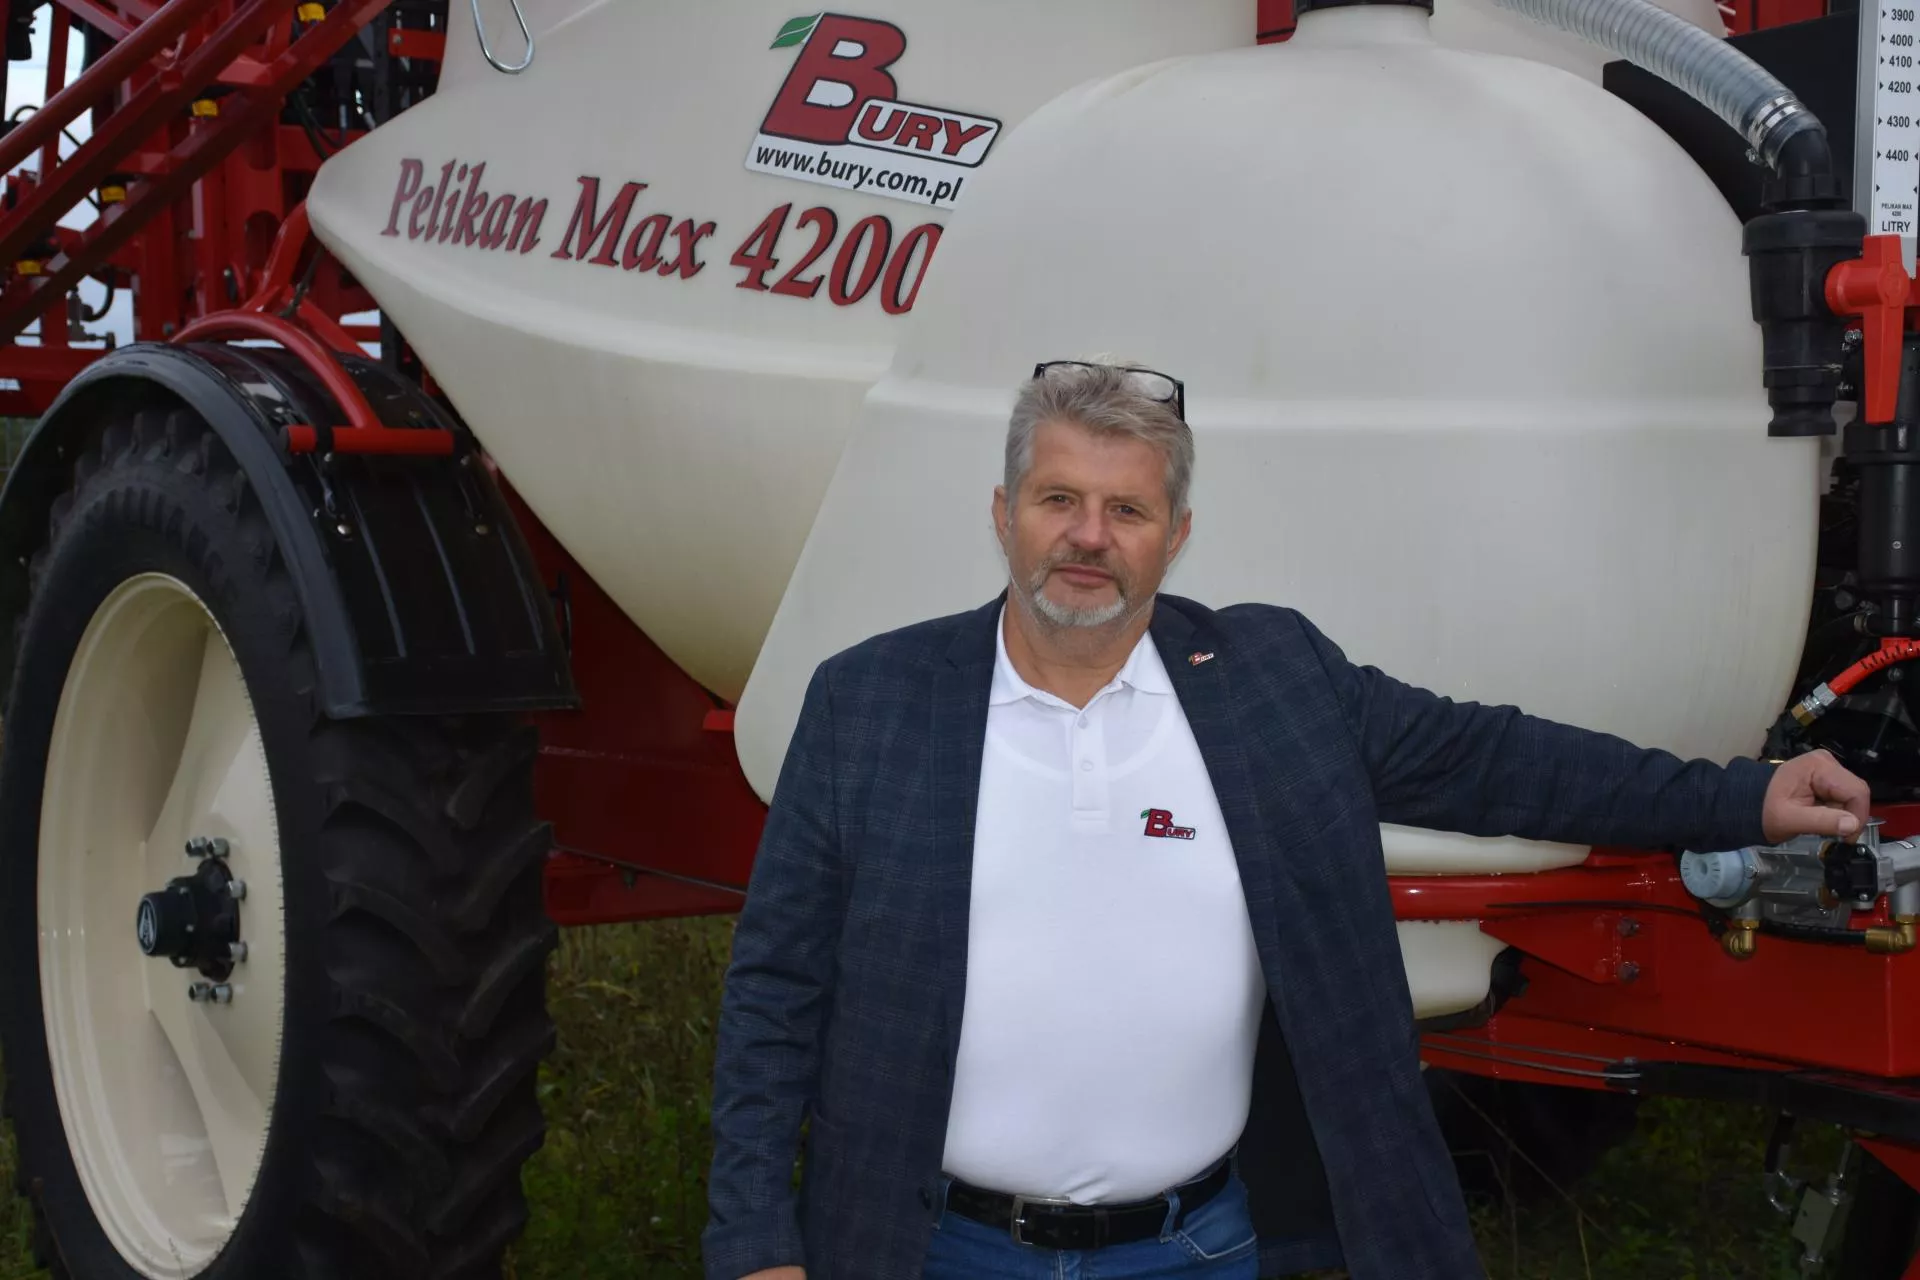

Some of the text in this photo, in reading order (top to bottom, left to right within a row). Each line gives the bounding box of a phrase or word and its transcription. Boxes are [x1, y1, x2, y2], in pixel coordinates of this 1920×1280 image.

[1891, 9, 1915, 22] 3900
[1890, 34, 1914, 47] 4000
[1888, 55, 1913, 68] 4100
[1888, 81, 1912, 93] 4200
[1887, 115, 1910, 128] 4300
[1886, 150, 1909, 162] 4400
[757, 146, 964, 205] www.bury.com.pl
[1882, 221, 1911, 232] LITRY
[380, 158, 944, 316] Pelikan Max 4200
